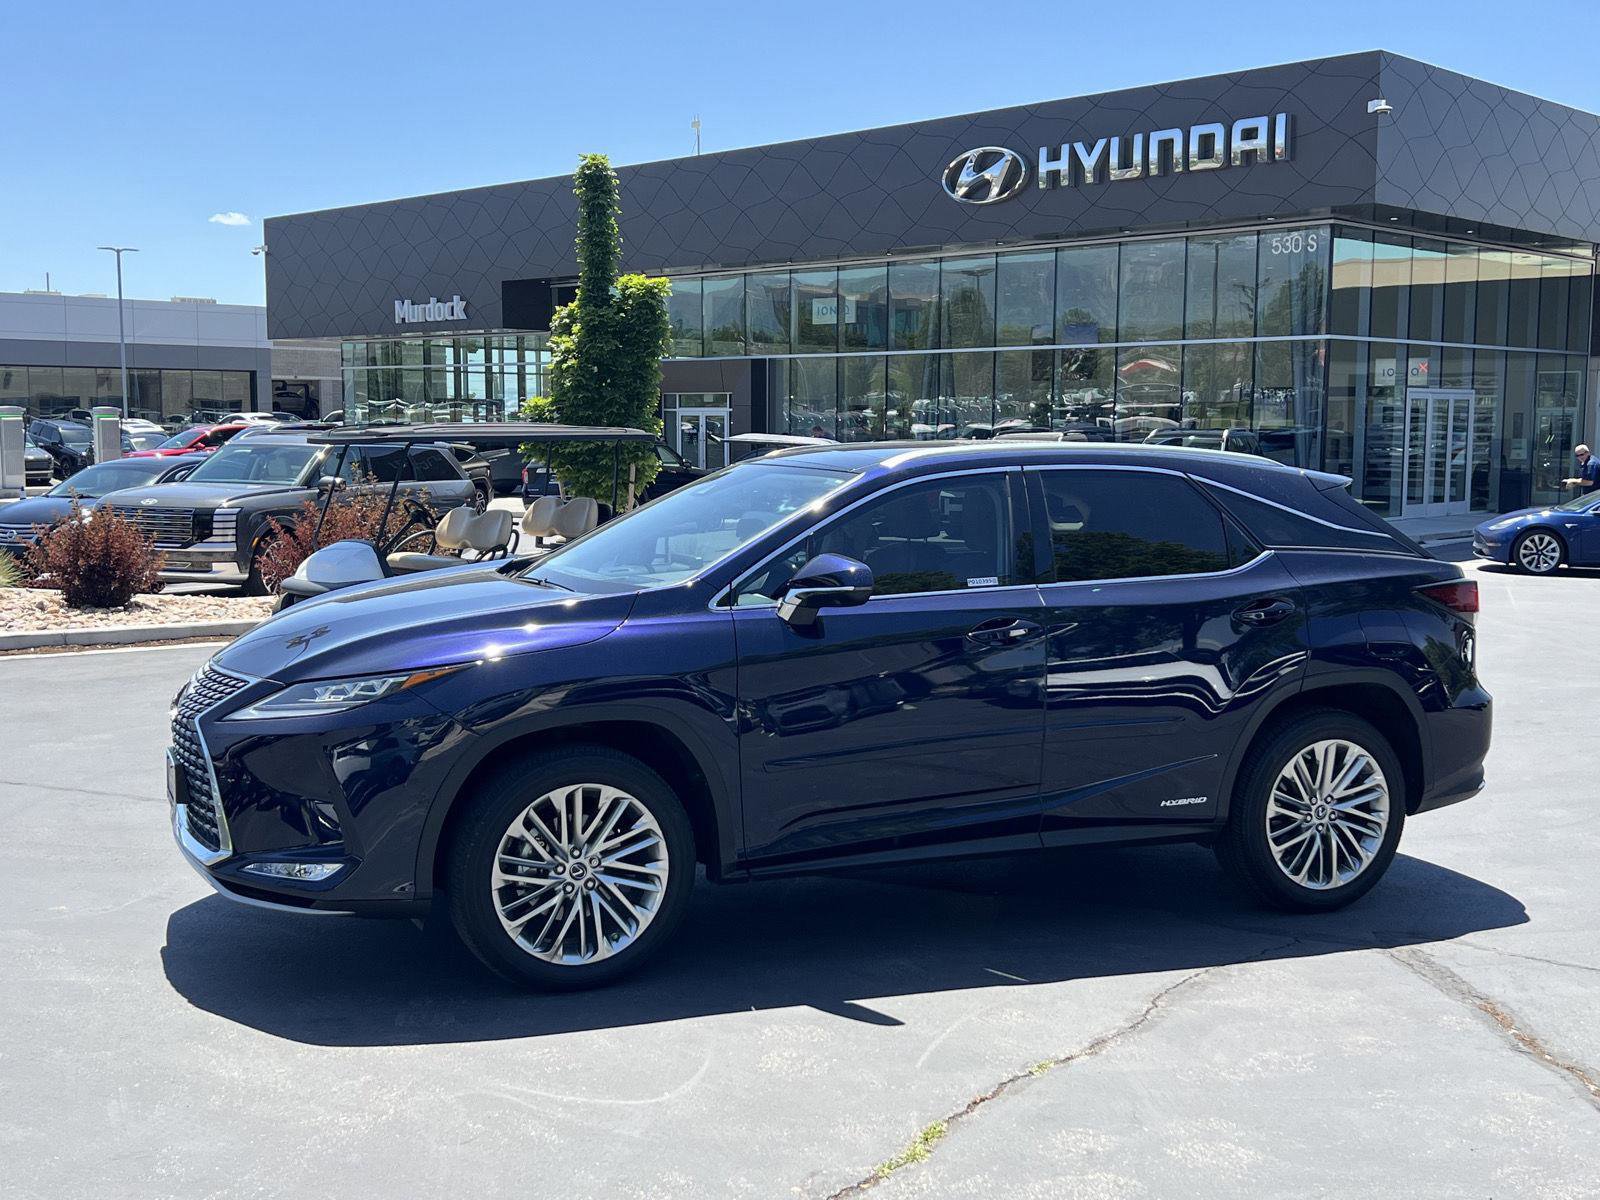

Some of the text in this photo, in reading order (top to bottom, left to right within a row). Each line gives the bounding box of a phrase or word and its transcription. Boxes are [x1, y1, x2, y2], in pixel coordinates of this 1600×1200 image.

[1038, 112, 1290, 190] HYUNDAI
[1271, 234, 1317, 255] 530 S
[394, 295, 468, 324] Murdock
[1160, 796, 1208, 807] HYBRID
